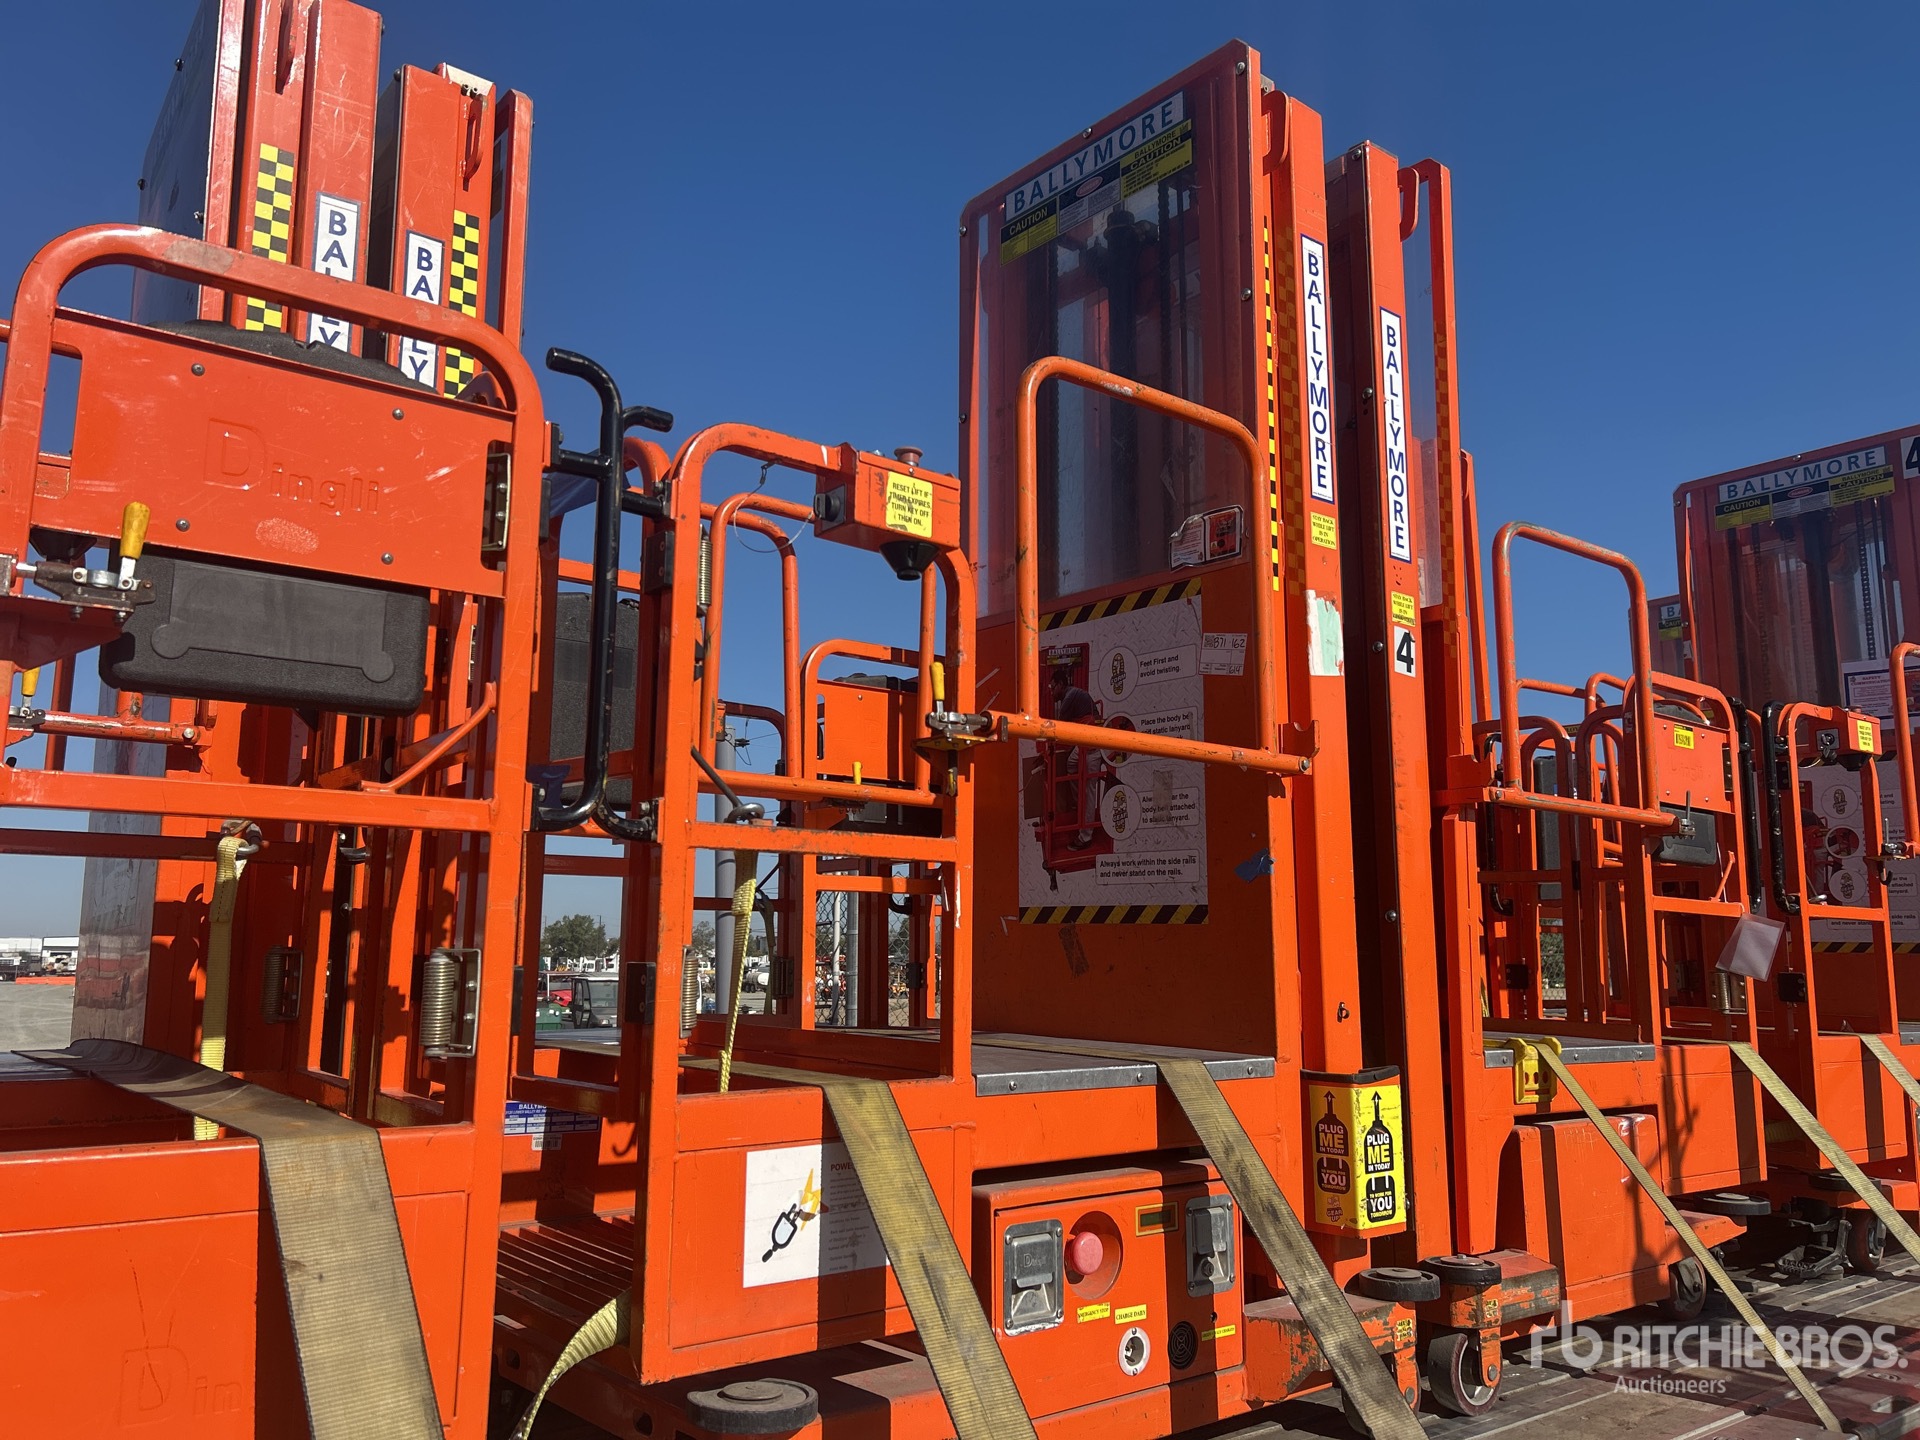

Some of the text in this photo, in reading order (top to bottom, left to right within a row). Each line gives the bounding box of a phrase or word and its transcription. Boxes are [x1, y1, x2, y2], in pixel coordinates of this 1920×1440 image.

[1135, 130, 1176, 159] BALLYMORE
[1014, 101, 1173, 213] BALLYMORE
[1131, 137, 1180, 170] CAUTION
[1009, 208, 1048, 235] CAUTION
[1308, 253, 1327, 489] BALLYMORE
[1386, 325, 1405, 549] BALLYMORE
[203, 417, 380, 516] Dingli
[1727, 451, 1876, 499] BALLYMORE
[893, 482, 910, 493] RESET
[911, 487, 922, 496] LIFT
[892, 502, 929, 517] TURN KEY OFF
[1723, 498, 1761, 512] CAUTION
[898, 513, 912, 523] THEN
[1312, 522, 1325, 530] WHILE
[1312, 536, 1336, 546] OPERATION
[1667, 605, 1681, 617] B
[1396, 631, 1414, 673] 4
[1139, 655, 1179, 668] Feet First and
[1140, 665, 1182, 678] avoid twisting.
[1140, 713, 1190, 726] Place the body be
[1142, 806, 1156, 814] body
[1170, 803, 1195, 811] attached
[1100, 859, 1120, 868] Always
[1121, 859, 1136, 867] work
[1137, 858, 1156, 866] within
[1182, 856, 1197, 864] rails
[1100, 870, 1111, 878] and
[1167, 868, 1183, 876] rails.
[1318, 1123, 1344, 1135] PLUG
[1319, 1134, 1344, 1149] ME
[1366, 1133, 1390, 1146] PLUG
[1367, 1145, 1390, 1164] ME
[830, 1162, 852, 1172] POWE
[1374, 1163, 1391, 1171] TODAY
[1321, 1173, 1347, 1187] YOU
[1321, 1183, 1346, 1191] TOMORROW
[1370, 1196, 1393, 1212] YOU
[1327, 1208, 1343, 1216] GEAR
[1331, 1214, 1340, 1222] UP
[1370, 1210, 1392, 1218] TOMORROW
[1116, 1309, 1146, 1320] CHARGE DAILY
